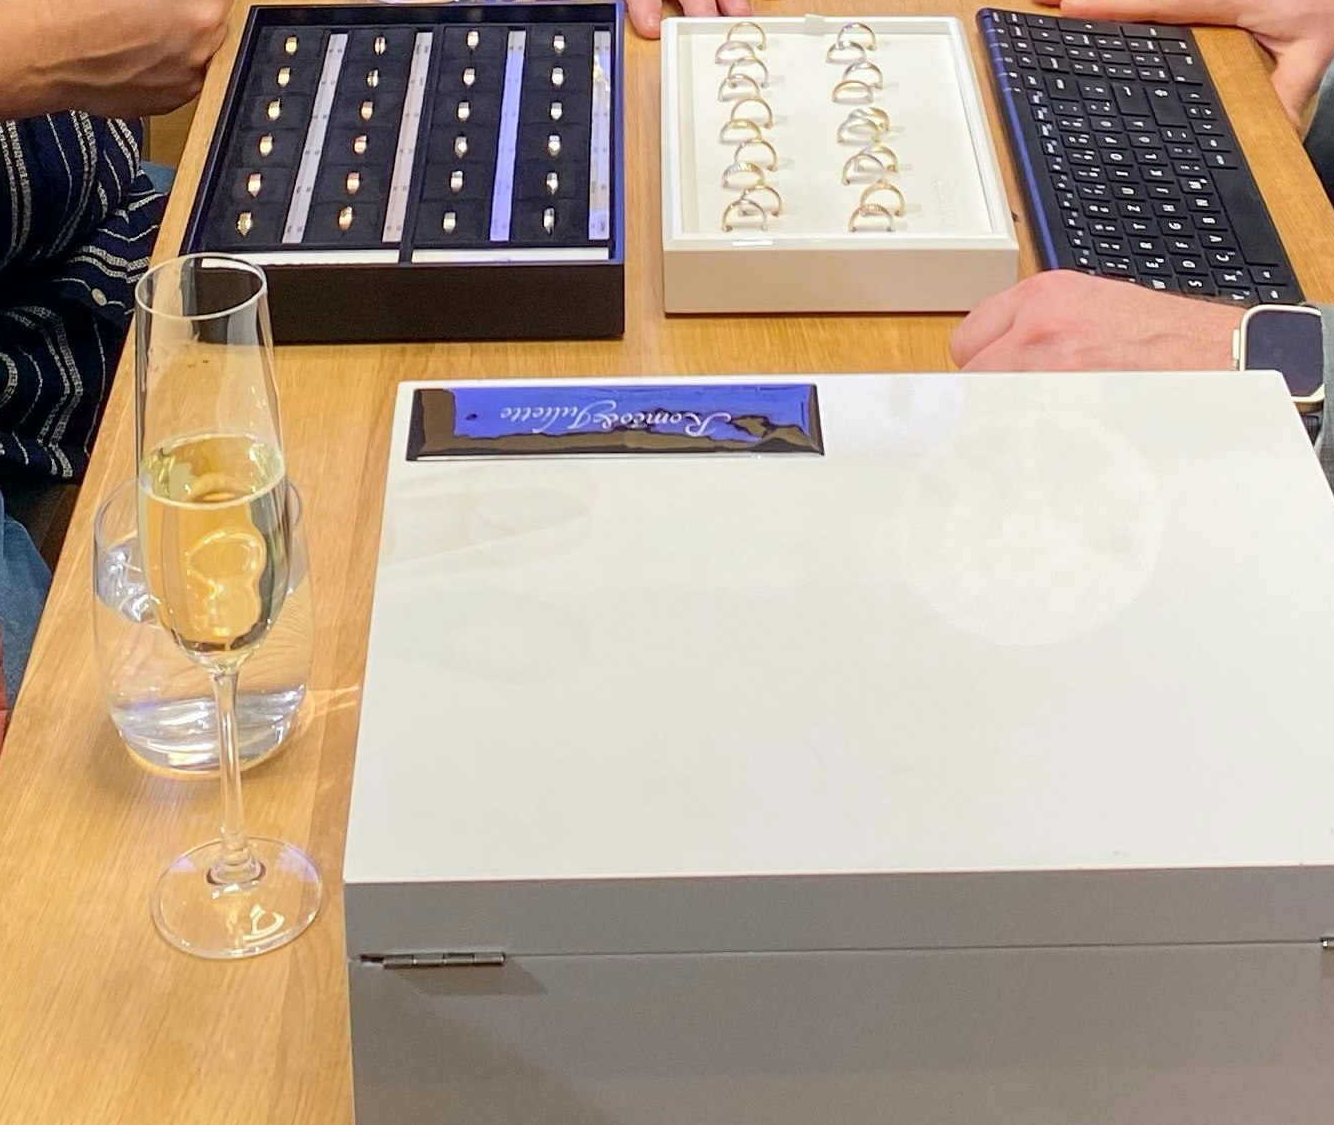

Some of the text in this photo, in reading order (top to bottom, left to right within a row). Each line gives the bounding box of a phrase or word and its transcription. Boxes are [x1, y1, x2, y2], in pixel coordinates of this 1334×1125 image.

[1149, 169, 1163, 177] K
[1188, 180, 1203, 190] M
[1121, 187, 1135, 195] U
[1195, 198, 1209, 207] N
[1126, 204, 1141, 213] Z
[1162, 204, 1176, 213] H
[1133, 223, 1146, 231] T
[1168, 222, 1182, 231] G
[1209, 235, 1223, 243] V
[1139, 241, 1153, 249] R
[1175, 241, 1189, 249] F
[1216, 254, 1230, 262] C
[1146, 261, 1160, 269] E
[1182, 260, 1196, 269] D
[1223, 274, 1237, 282] X
[1151, 279, 1166, 289] W
[1188, 280, 1203, 288] S
